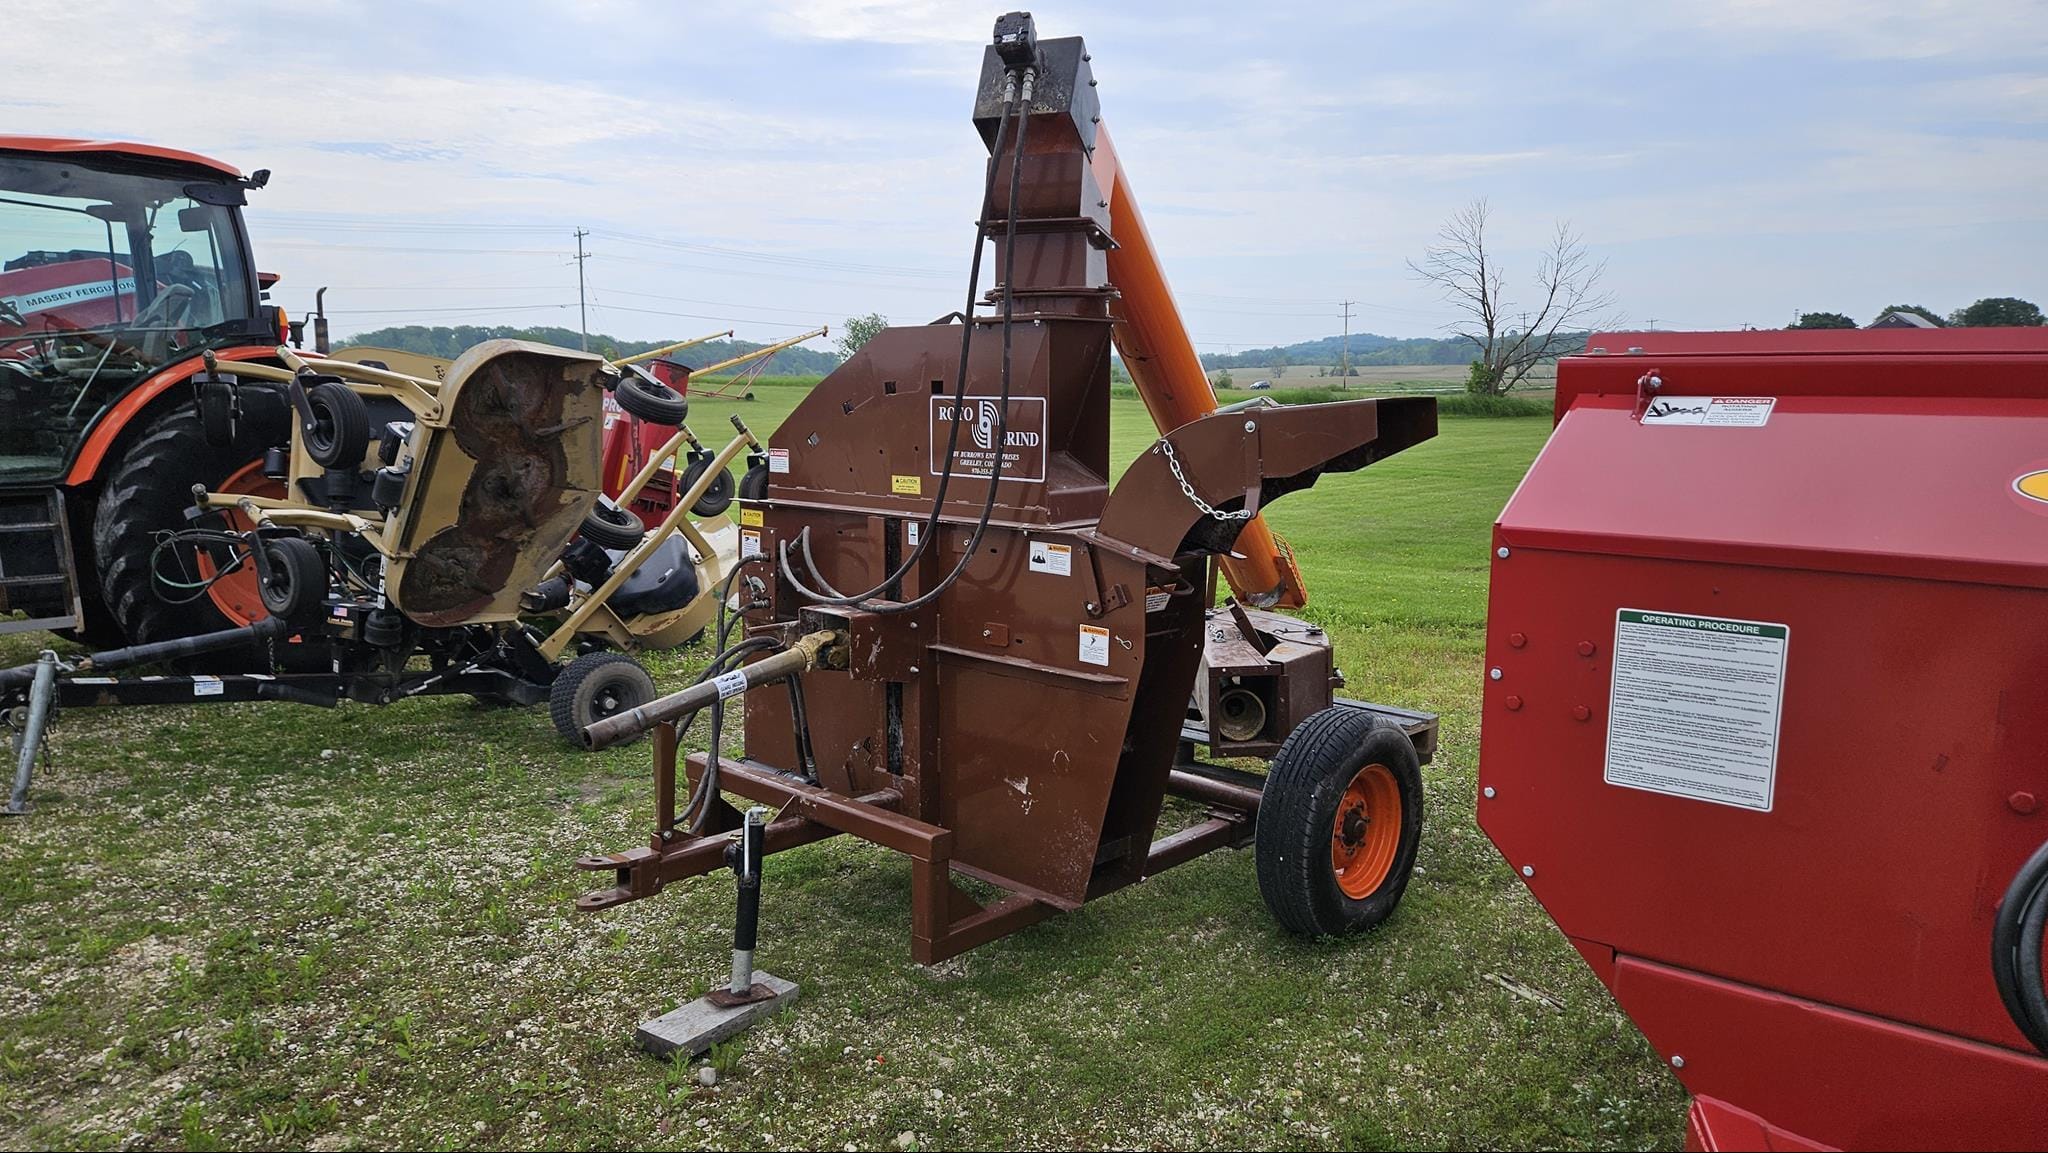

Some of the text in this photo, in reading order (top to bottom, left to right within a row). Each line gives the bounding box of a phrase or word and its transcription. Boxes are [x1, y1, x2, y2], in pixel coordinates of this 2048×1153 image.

[26, 291, 73, 306] MASSEY
[939, 407, 973, 421] ROO
[985, 452, 1020, 461] ENTPRISES
[984, 460, 1012, 468] COLADO
[1641, 614, 1760, 634] OPERATING PROCEDURE
